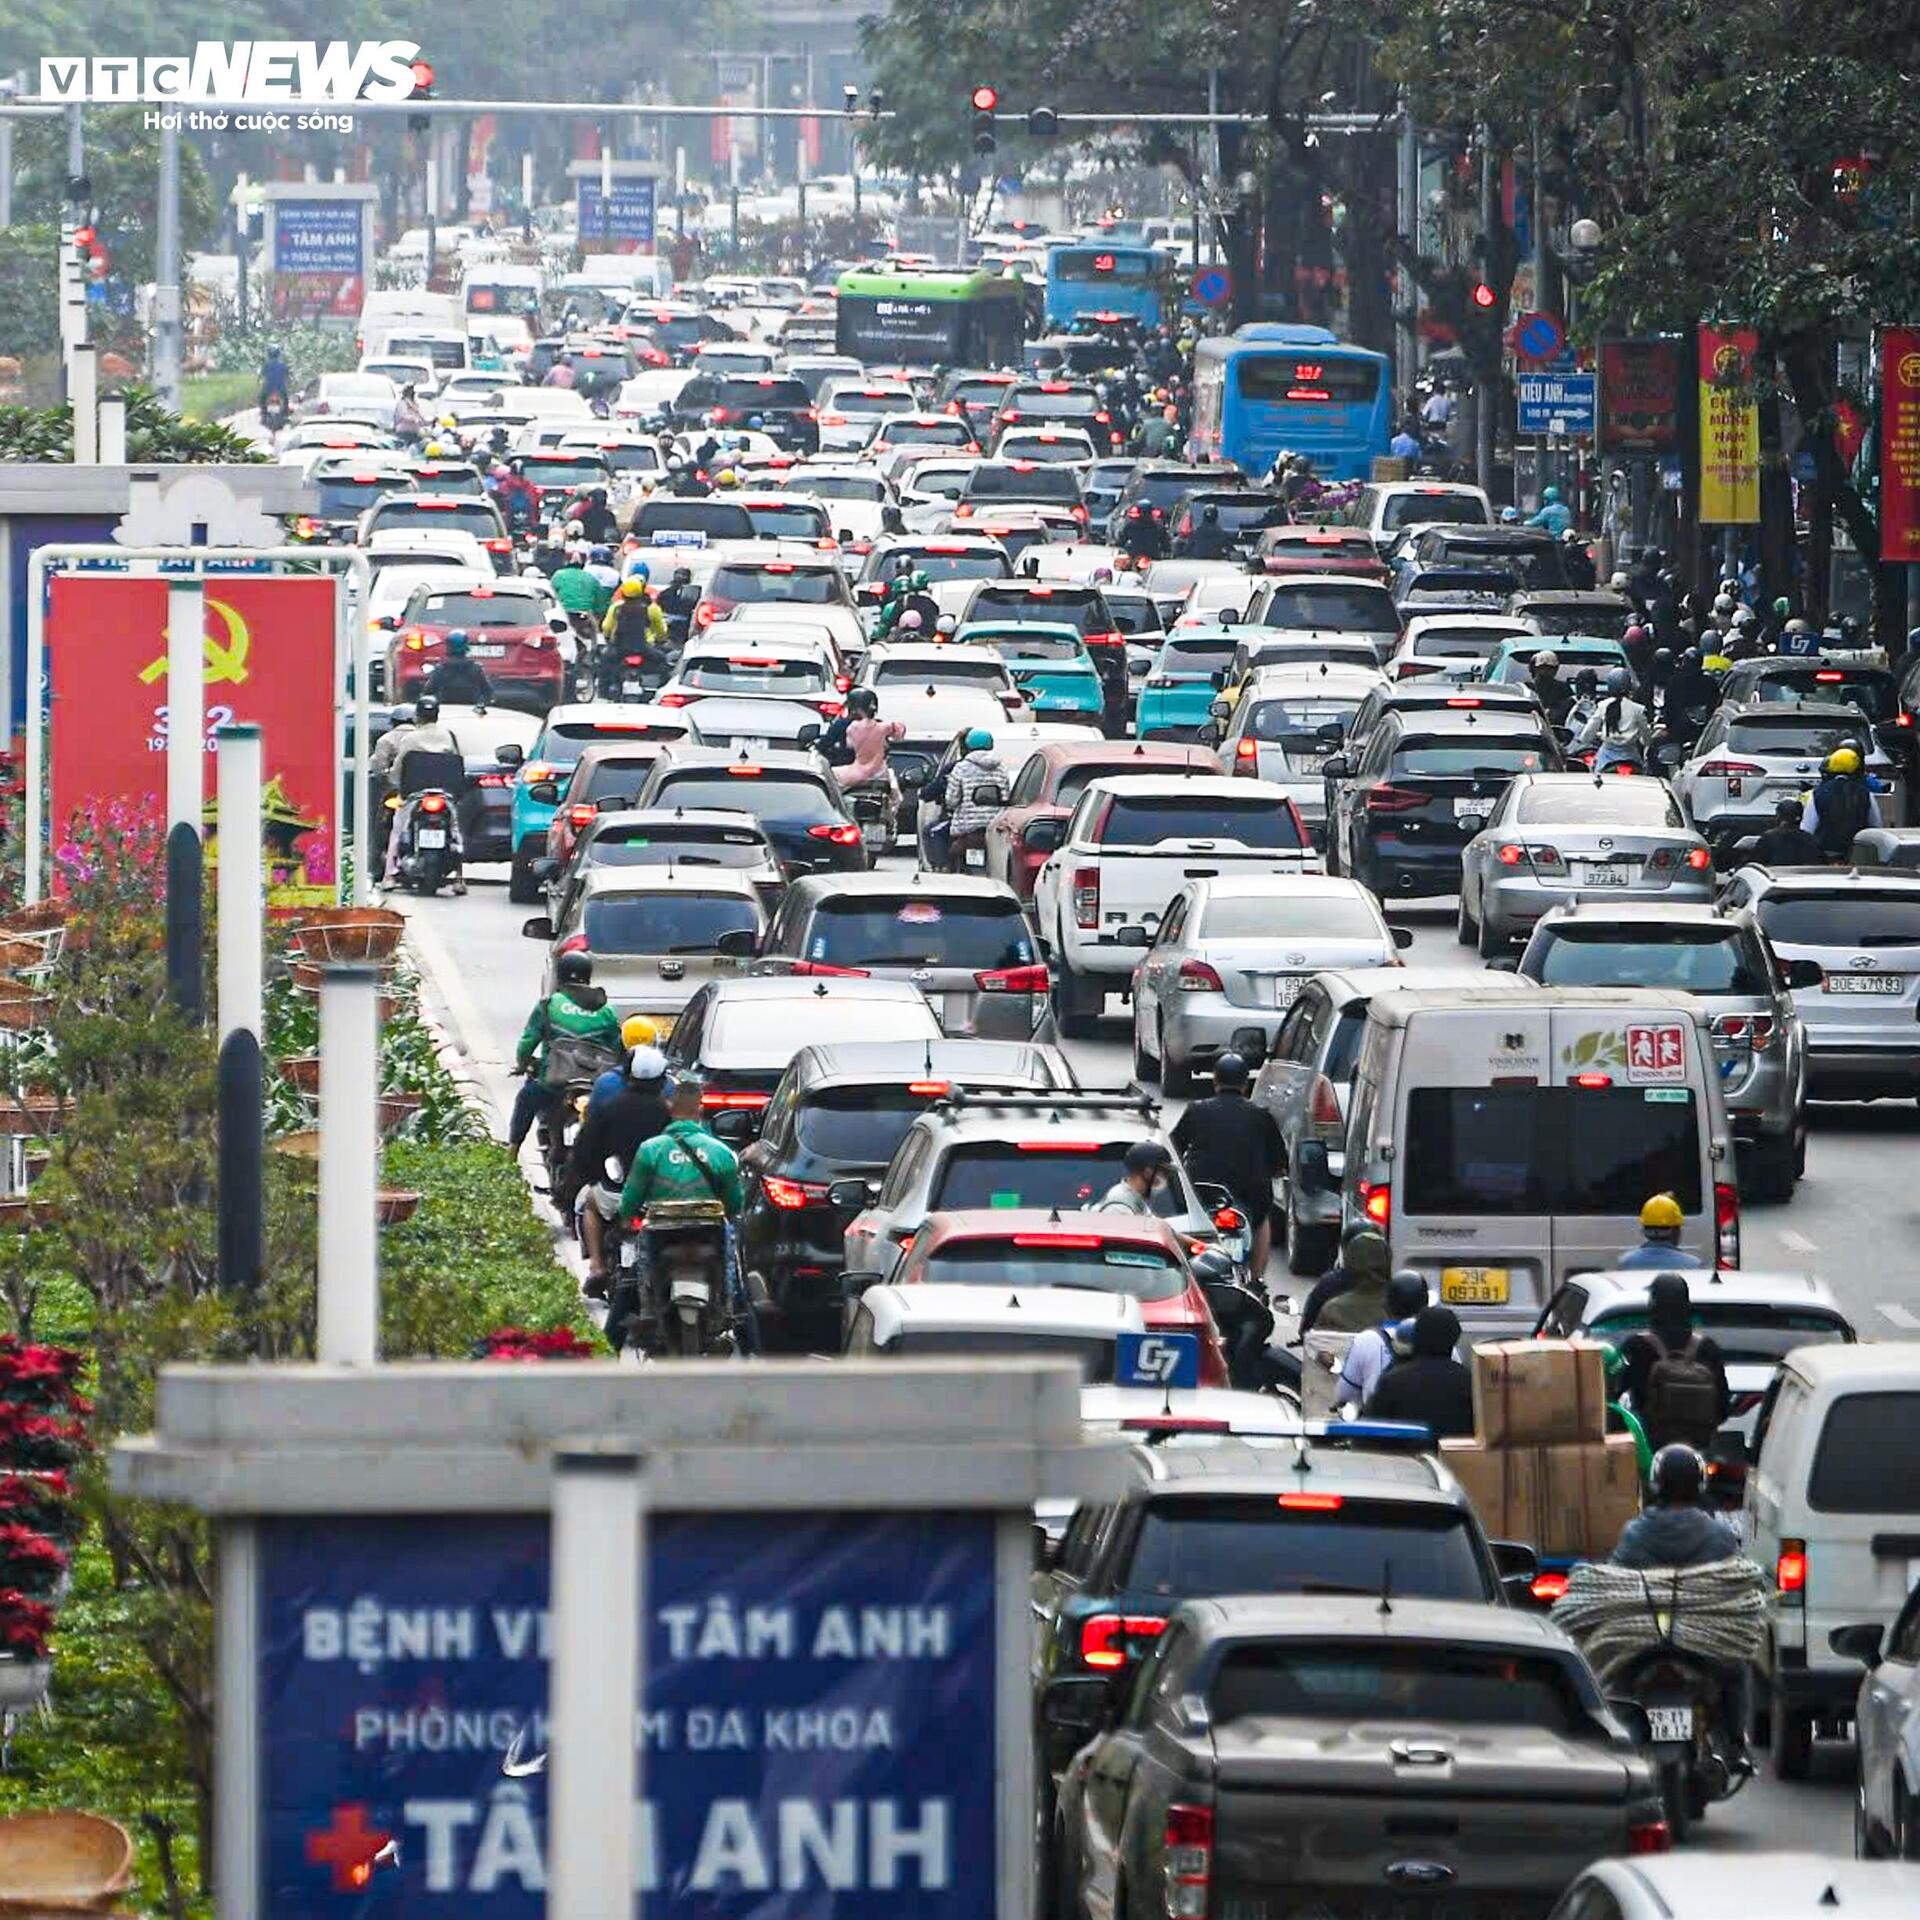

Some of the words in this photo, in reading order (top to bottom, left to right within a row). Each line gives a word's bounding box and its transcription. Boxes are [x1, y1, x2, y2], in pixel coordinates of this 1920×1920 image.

[325, 232, 357, 246] ANH
[153, 705, 233, 735] 32
[668, 1148, 708, 1164] Grb
[302, 1598, 476, 1676] BỆNH
[659, 1598, 794, 1660] TÂM
[812, 1608, 950, 1660] ANH
[354, 1706, 519, 1752] PHÒNG
[687, 1711, 747, 1751] ĐA
[765, 1711, 891, 1751] KHOA
[688, 1799, 950, 1891] ANH
